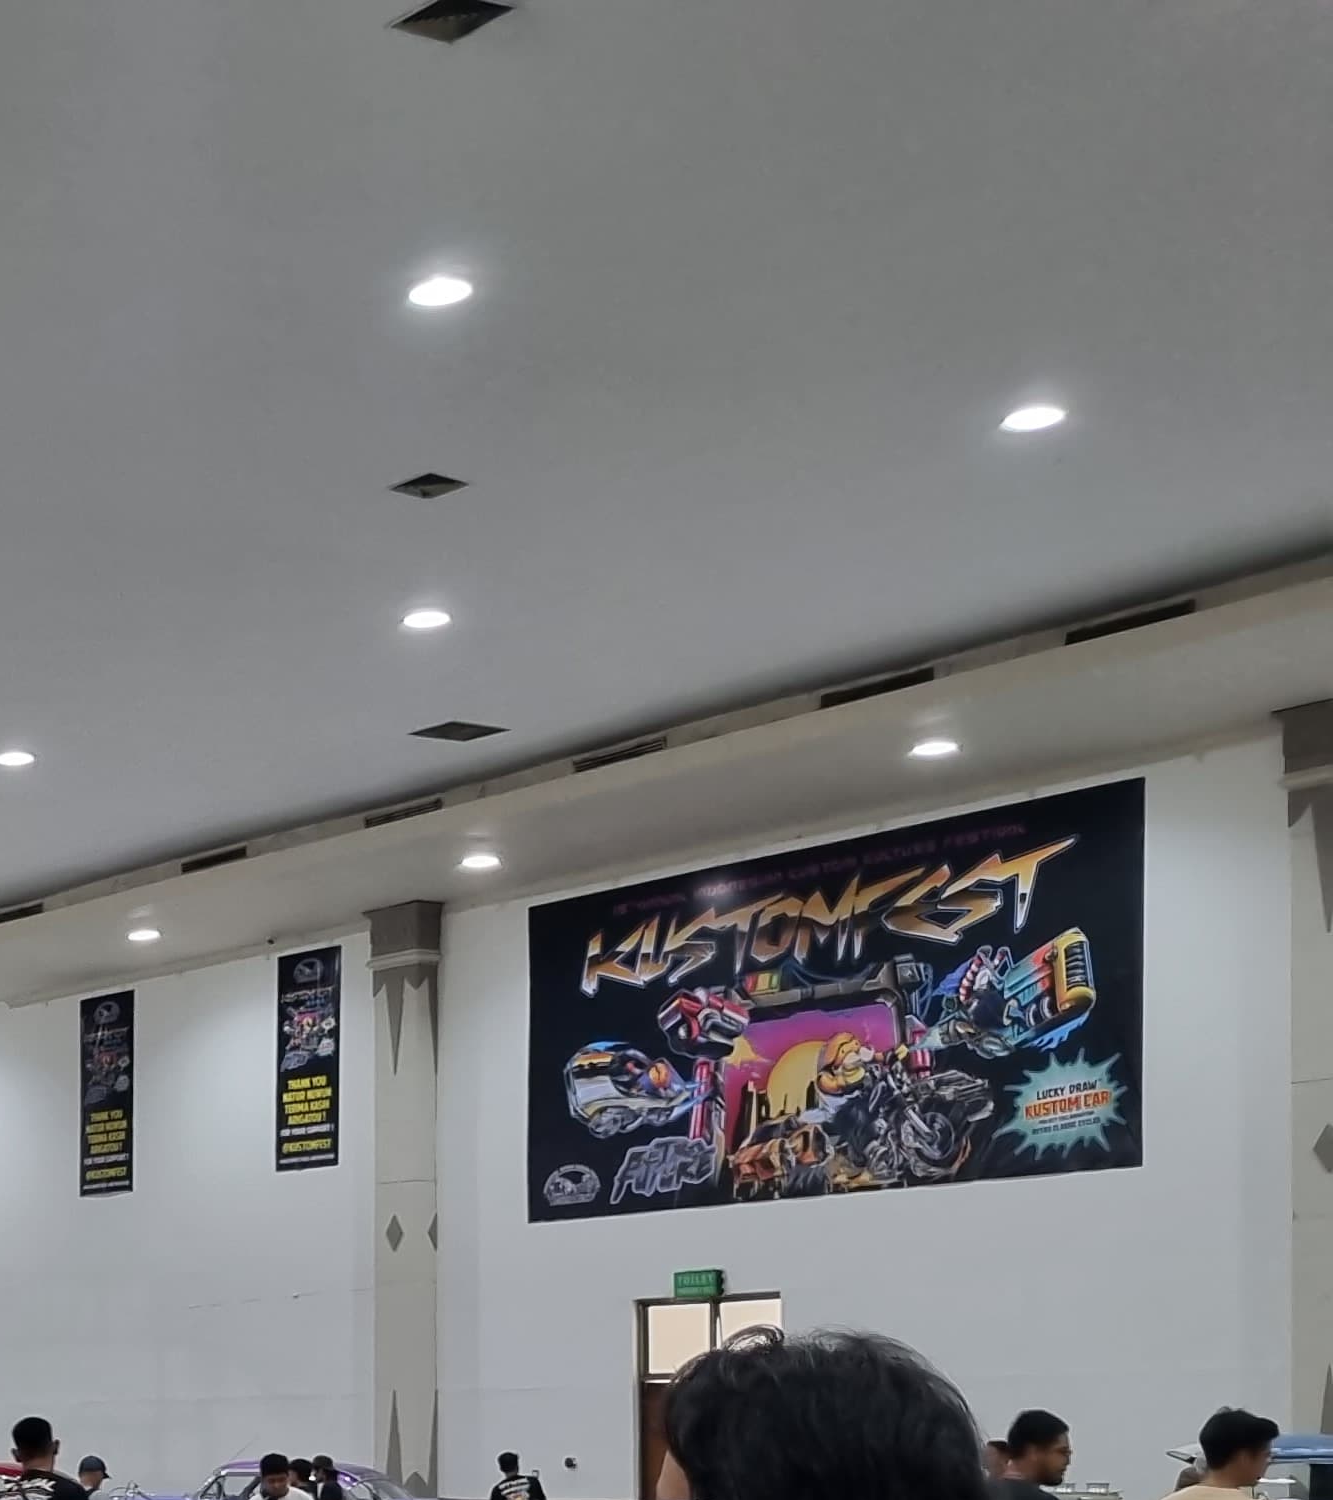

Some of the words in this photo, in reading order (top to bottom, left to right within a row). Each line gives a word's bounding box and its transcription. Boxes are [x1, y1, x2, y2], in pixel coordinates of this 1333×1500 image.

[1036, 1087, 1065, 1101] LUCKY
[1068, 1079, 1098, 1094] DRAW
[1024, 1096, 1082, 1121] KUSTOM
[1083, 1091, 1112, 1110] CAR
